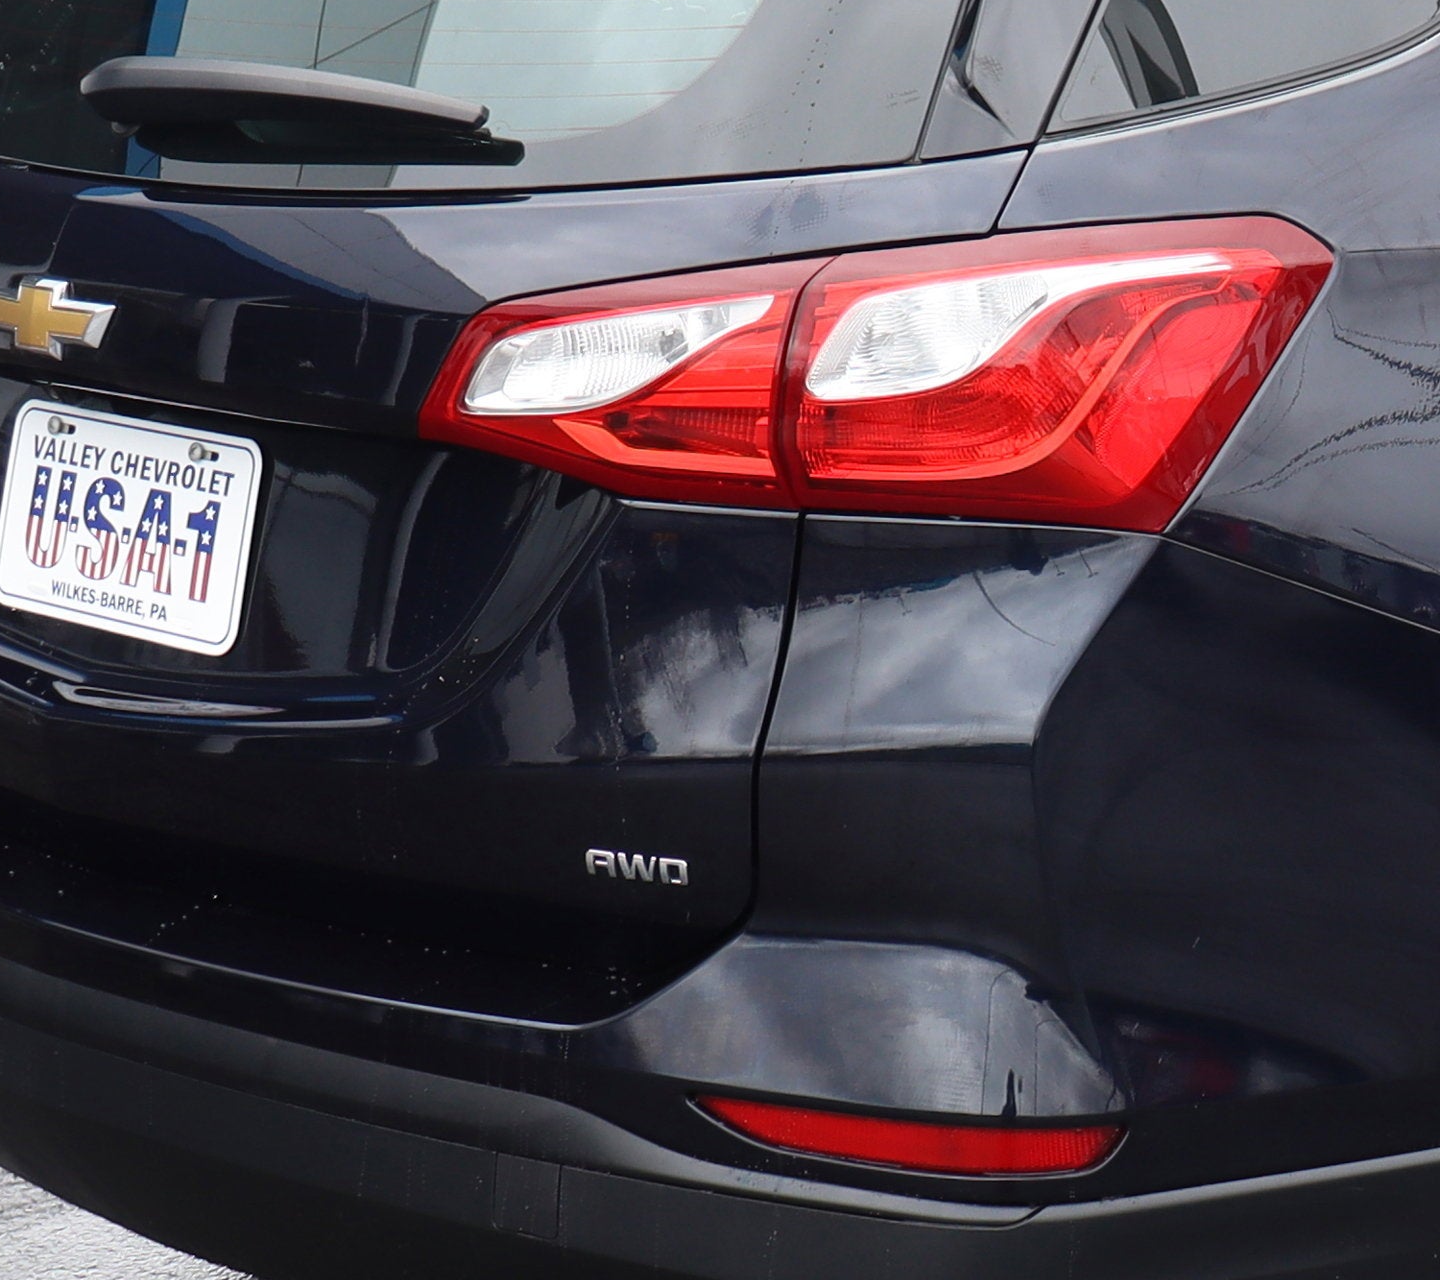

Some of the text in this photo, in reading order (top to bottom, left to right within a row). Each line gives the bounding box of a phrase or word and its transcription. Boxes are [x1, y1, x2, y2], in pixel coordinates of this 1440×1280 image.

[33, 434, 236, 498] VALLEY CHEVROLET
[51, 578, 168, 622] WILKES-BARRE, PA
[585, 848, 689, 886] AWD
